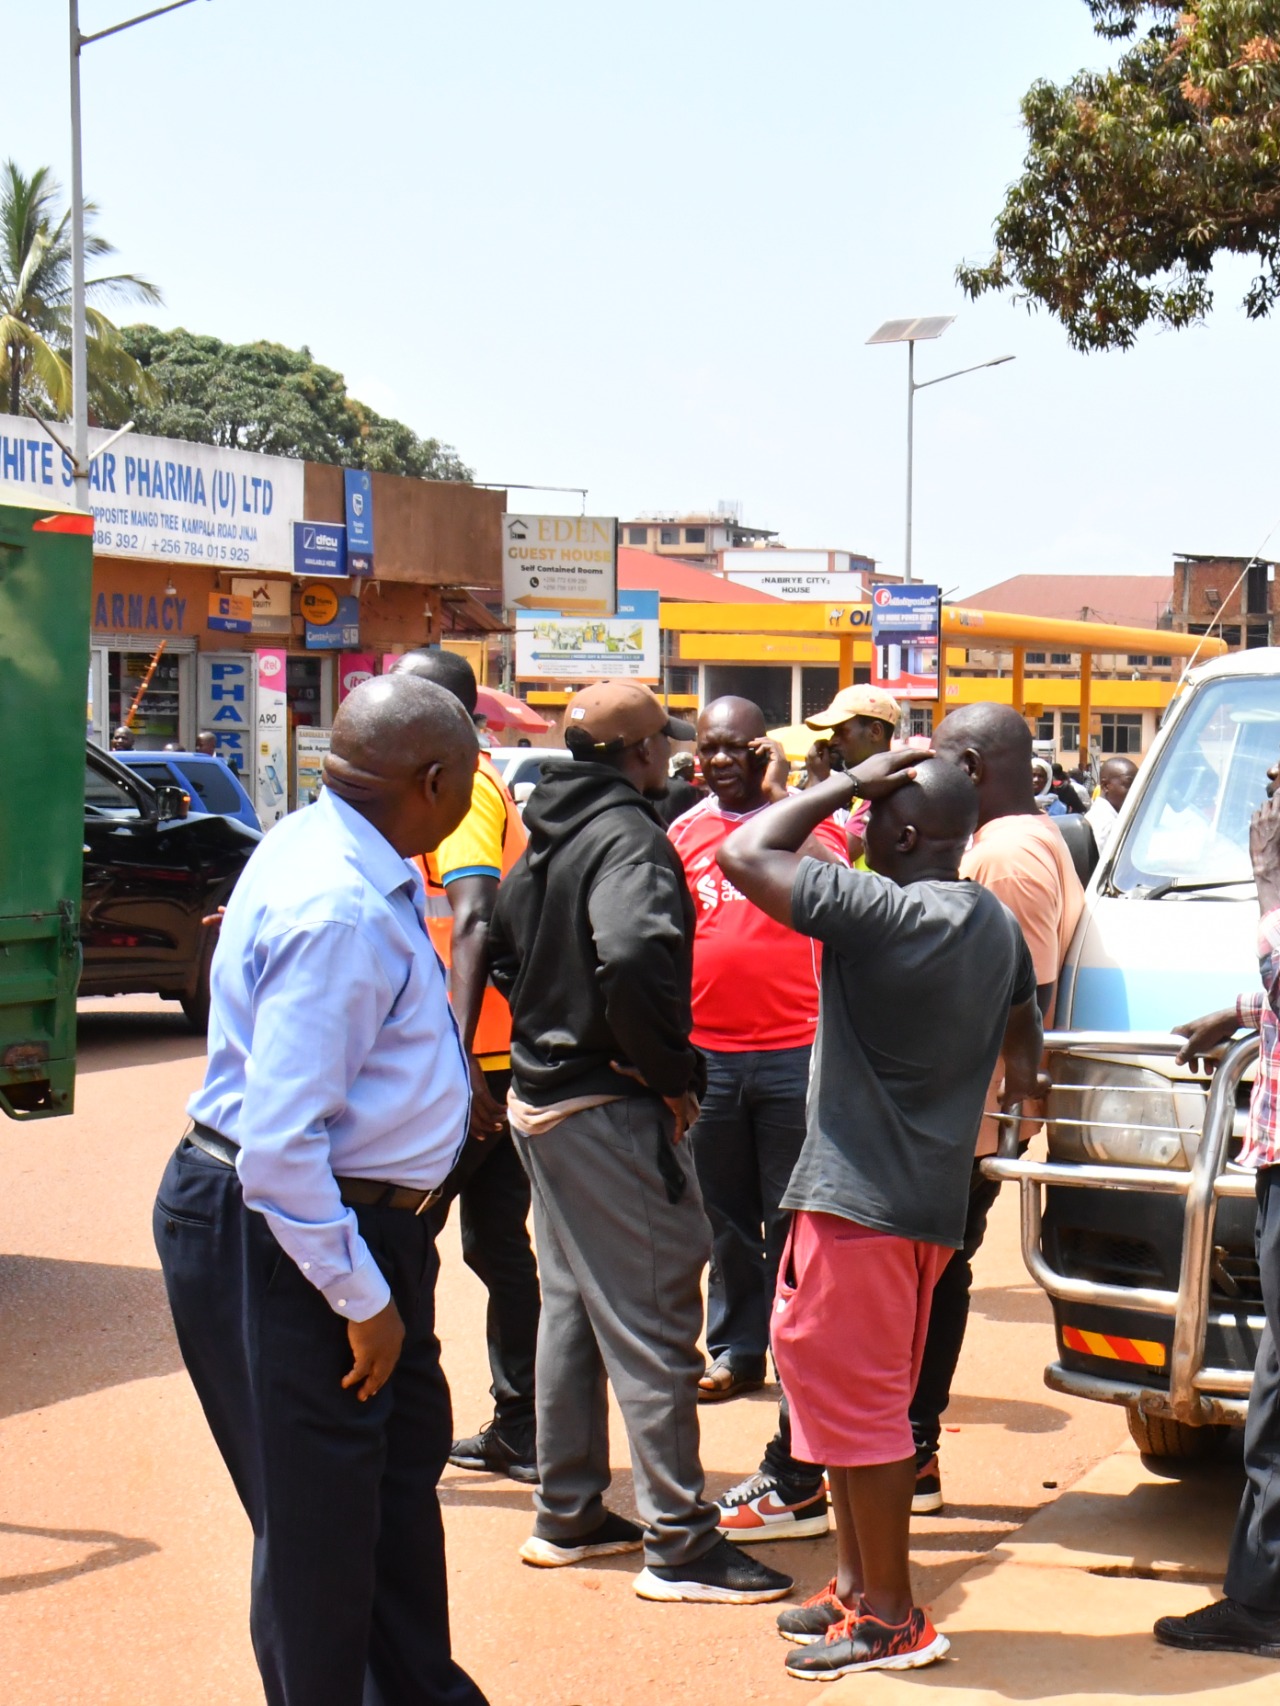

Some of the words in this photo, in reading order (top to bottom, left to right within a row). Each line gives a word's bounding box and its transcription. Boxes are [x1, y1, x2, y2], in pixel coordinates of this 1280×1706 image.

[0, 435, 53, 486] HITE
[61, 446, 116, 494] SAR
[125, 456, 206, 508] PHARMA
[212, 469, 236, 518] (U)
[242, 475, 273, 516] LTD
[89, 505, 128, 526] OPPOSITE
[131, 509, 158, 528] MANGO
[160, 513, 179, 531] TREE
[182, 517, 215, 538] KAMPALA
[217, 522, 237, 540] ROAD
[239, 525, 258, 542] JINJA
[538, 517, 610, 544] EDEN
[116, 532, 138, 549] 392
[151, 537, 181, 555] +256
[184, 540, 204, 557] 784
[207, 543, 227, 560] 015
[230, 546, 250, 562] 925
[316, 534, 338, 547] dfcu
[508, 547, 556, 560] GUEST
[561, 549, 612, 563] HOUSE
[521, 564, 536, 572] Self
[537, 565, 576, 574] Contained
[577, 567, 604, 575] Rooms
[264, 659, 278, 670] itel
[258, 713, 277, 724] A90
